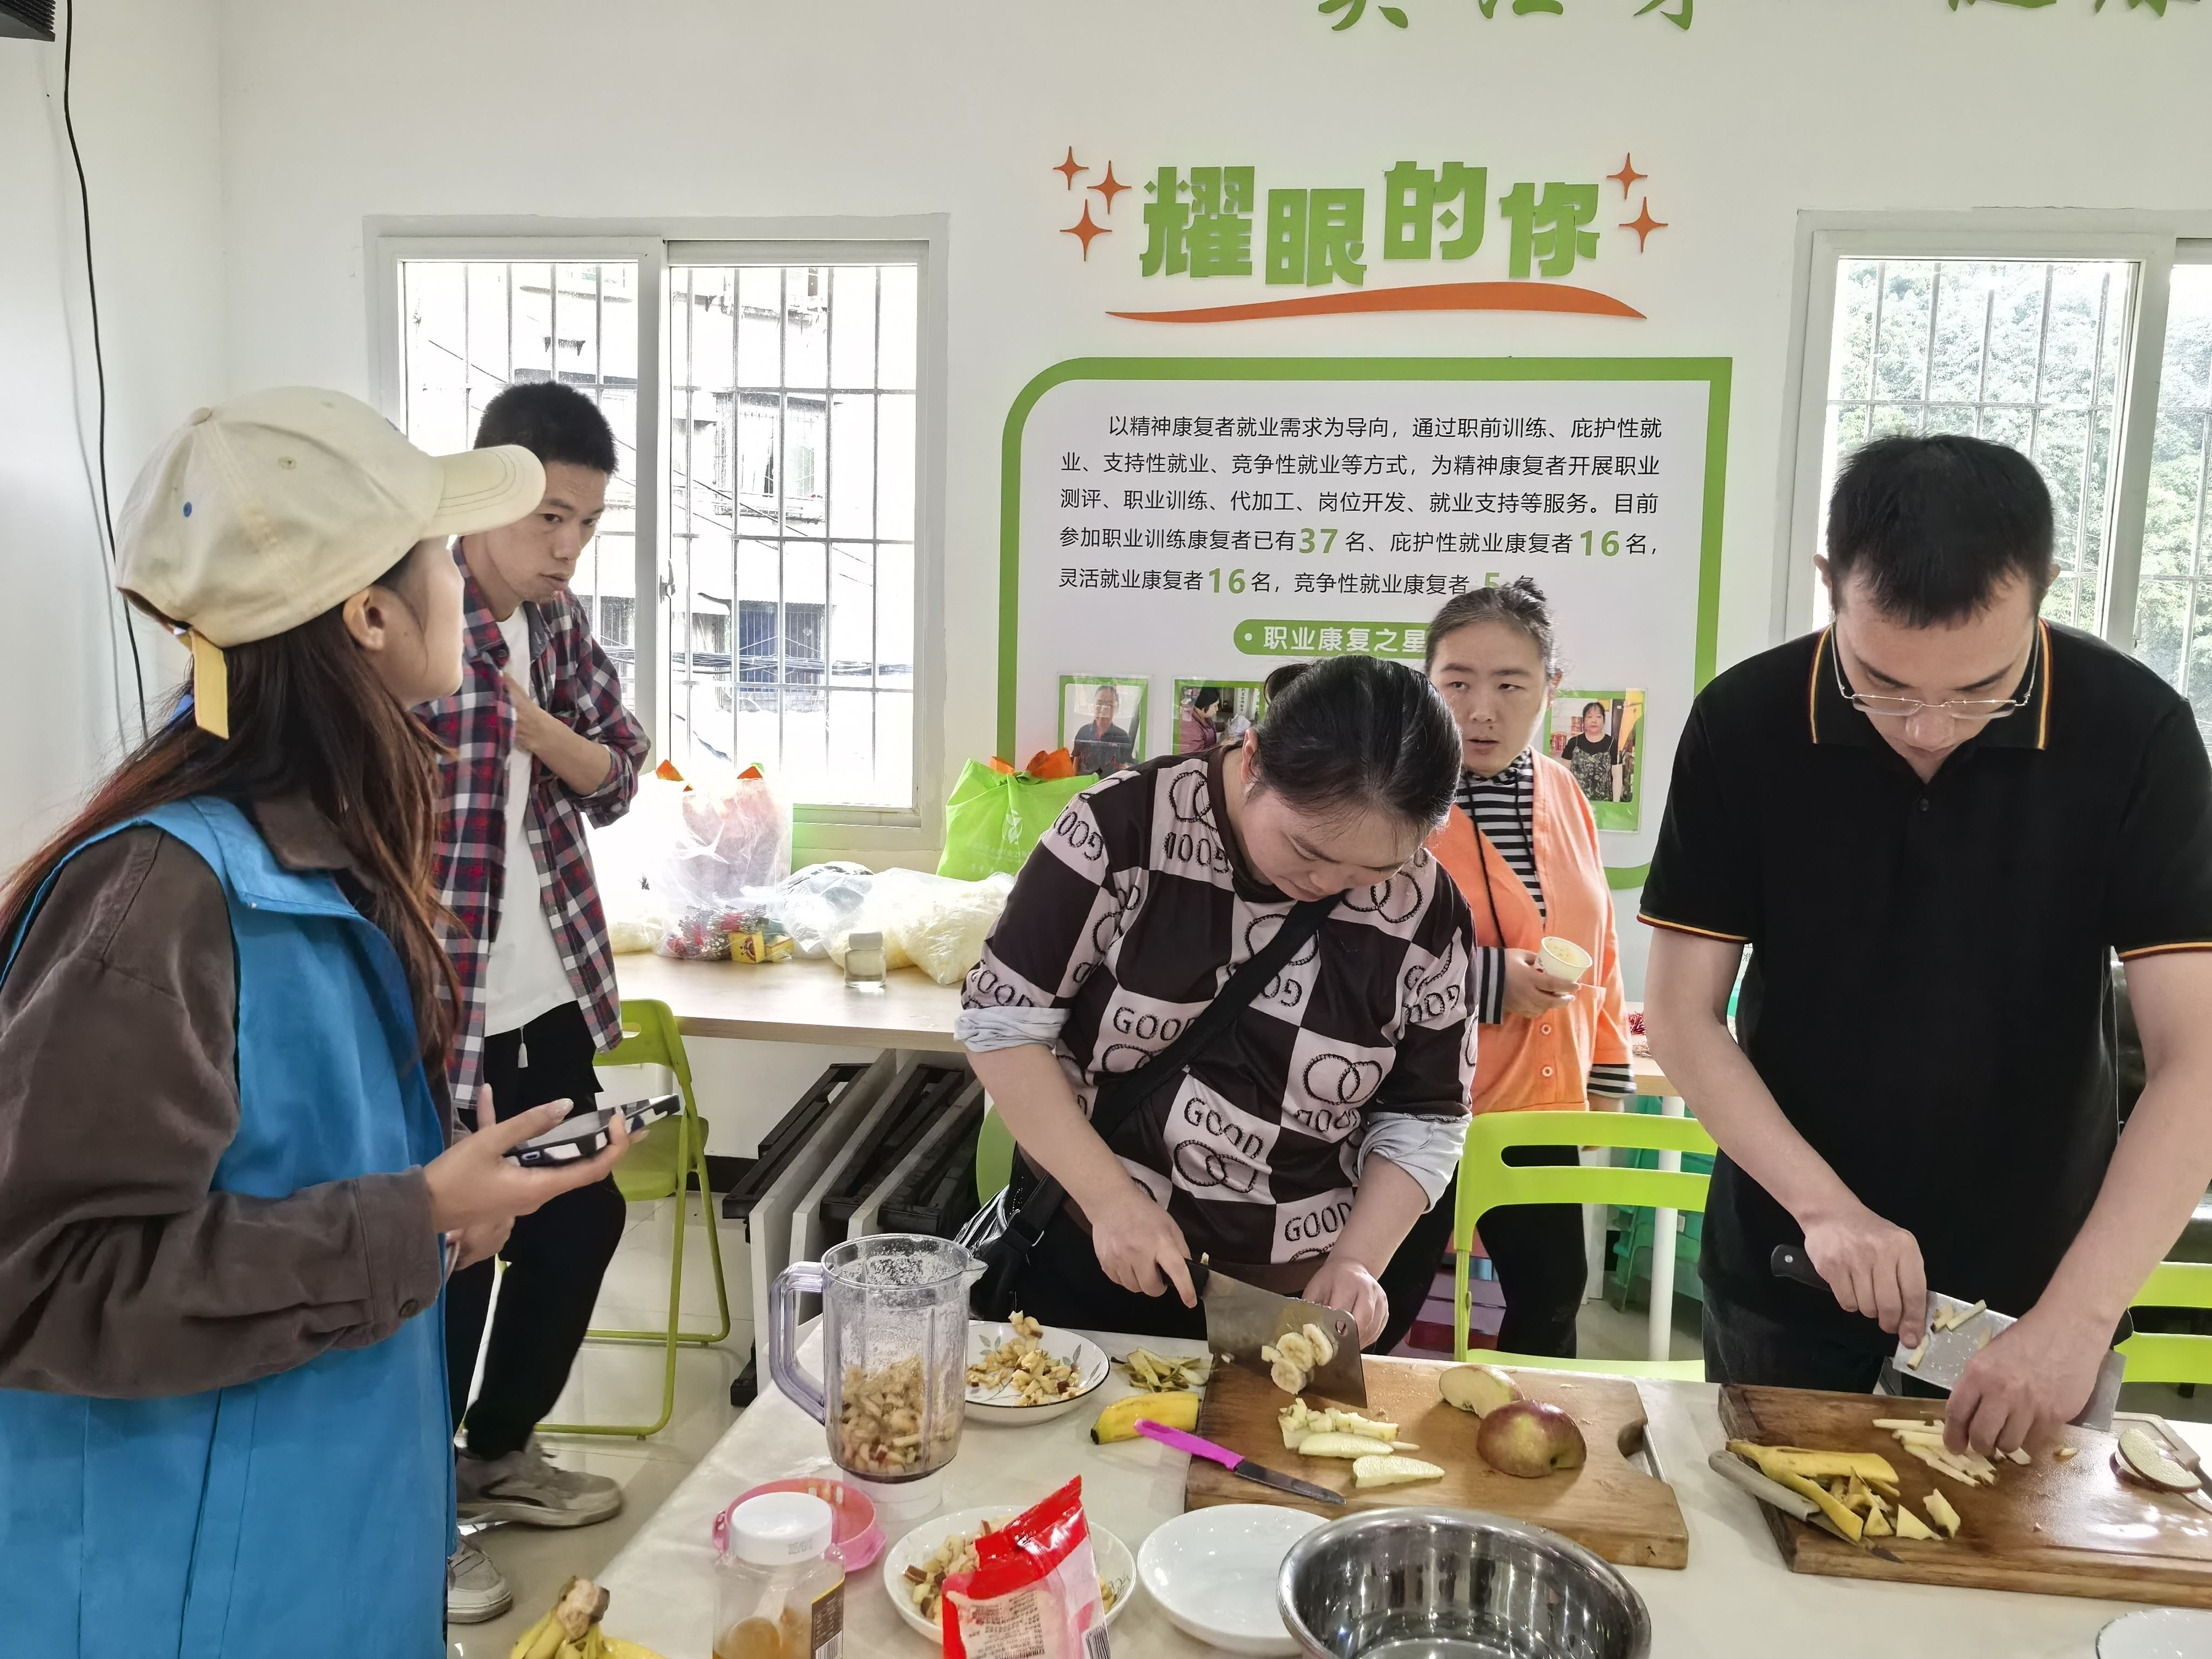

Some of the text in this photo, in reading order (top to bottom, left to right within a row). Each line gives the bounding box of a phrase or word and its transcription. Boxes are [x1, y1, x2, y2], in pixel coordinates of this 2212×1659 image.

[1139, 160, 1600, 287] 耀眼的你
[1109, 416, 1662, 439] 以精神康复者就业需求为导向，通过职前训练、庇护性就
[1061, 451, 1660, 476] 业、支持性就业、竞争性就业等方式，为精神康复者开展职业
[1060, 488, 1658, 514] 测评、职业训练、代加工、岗位开发、就业支持等服务。目前
[1264, 625, 1426, 652] 职业康复之星
[1184, 1097, 1264, 1159] GOOD
